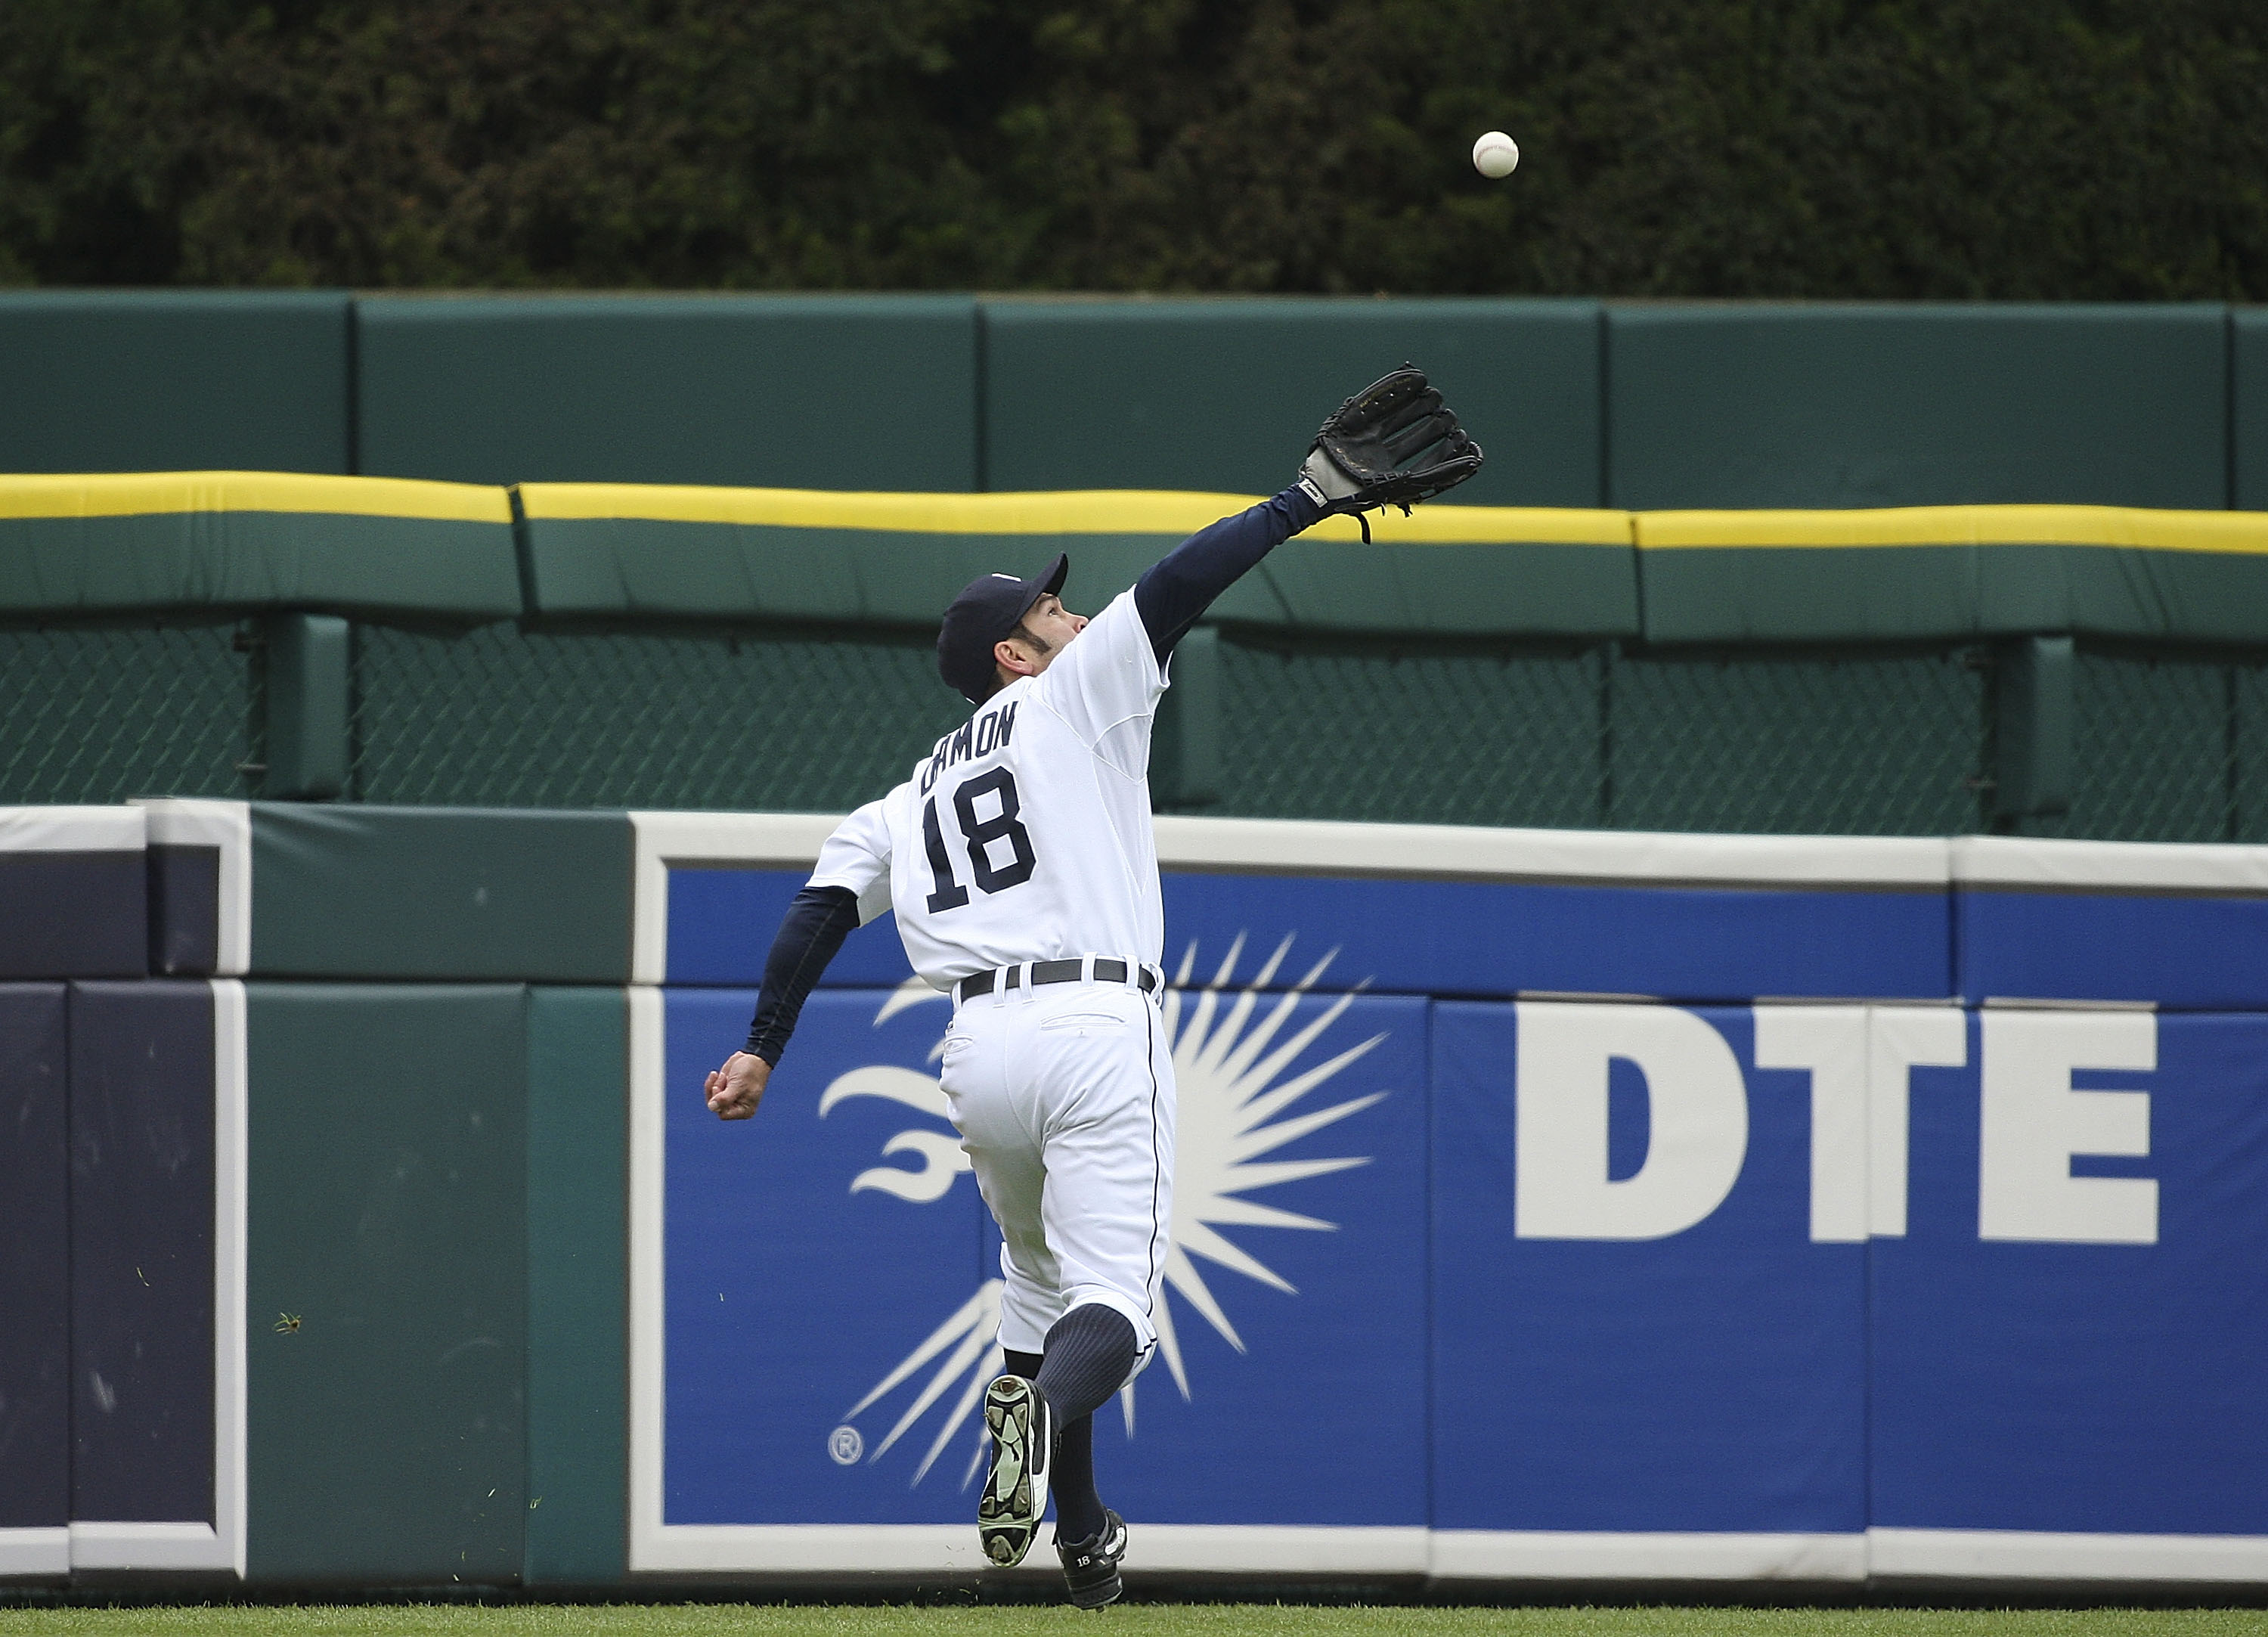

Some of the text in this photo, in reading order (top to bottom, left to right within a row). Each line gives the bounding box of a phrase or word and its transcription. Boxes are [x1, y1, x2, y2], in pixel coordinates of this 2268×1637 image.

[922, 765, 1037, 915] 18
[1514, 997, 2159, 1245] DTE
[1077, 1555, 1091, 1567] 18
